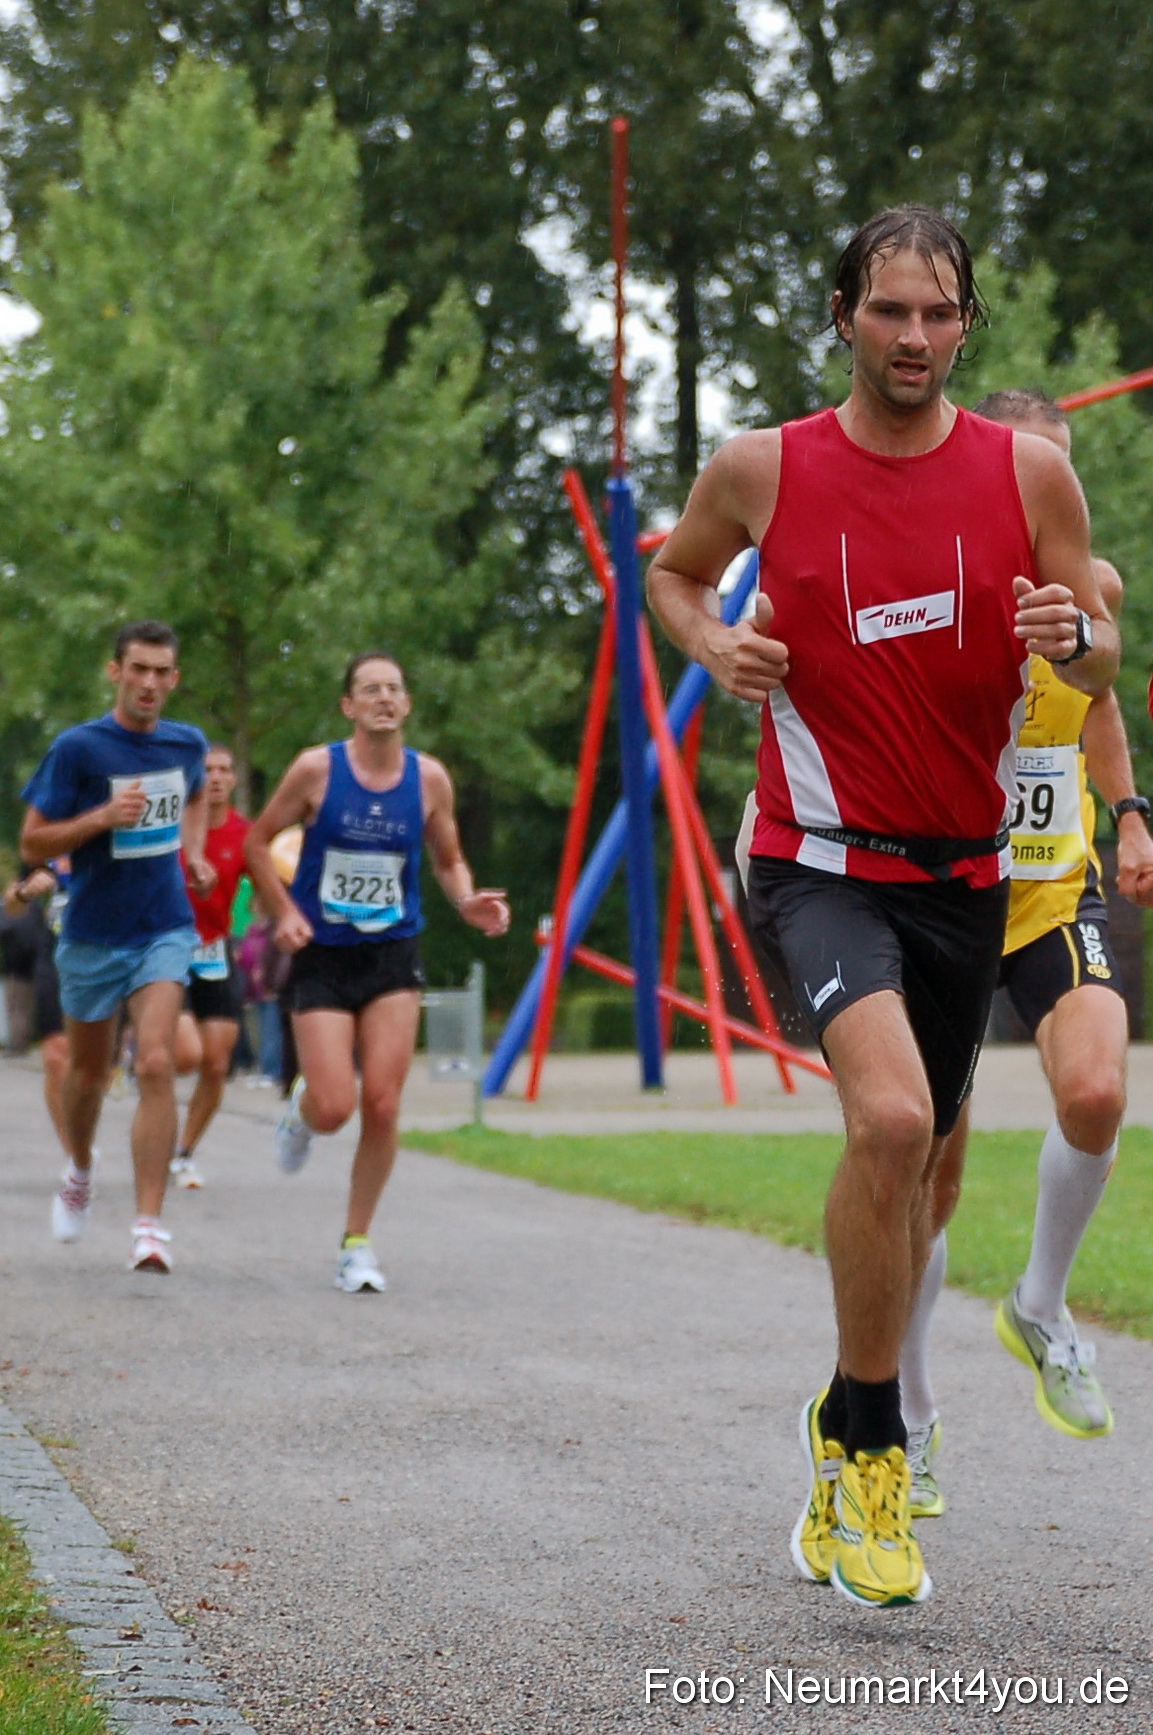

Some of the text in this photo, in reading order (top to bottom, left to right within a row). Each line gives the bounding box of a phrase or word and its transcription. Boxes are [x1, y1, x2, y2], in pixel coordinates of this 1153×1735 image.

[883, 607, 928, 629] DEHN
[868, 837, 907, 857] Extra
[1011, 845, 1055, 861] omas
[331, 873, 397, 905] 3225
